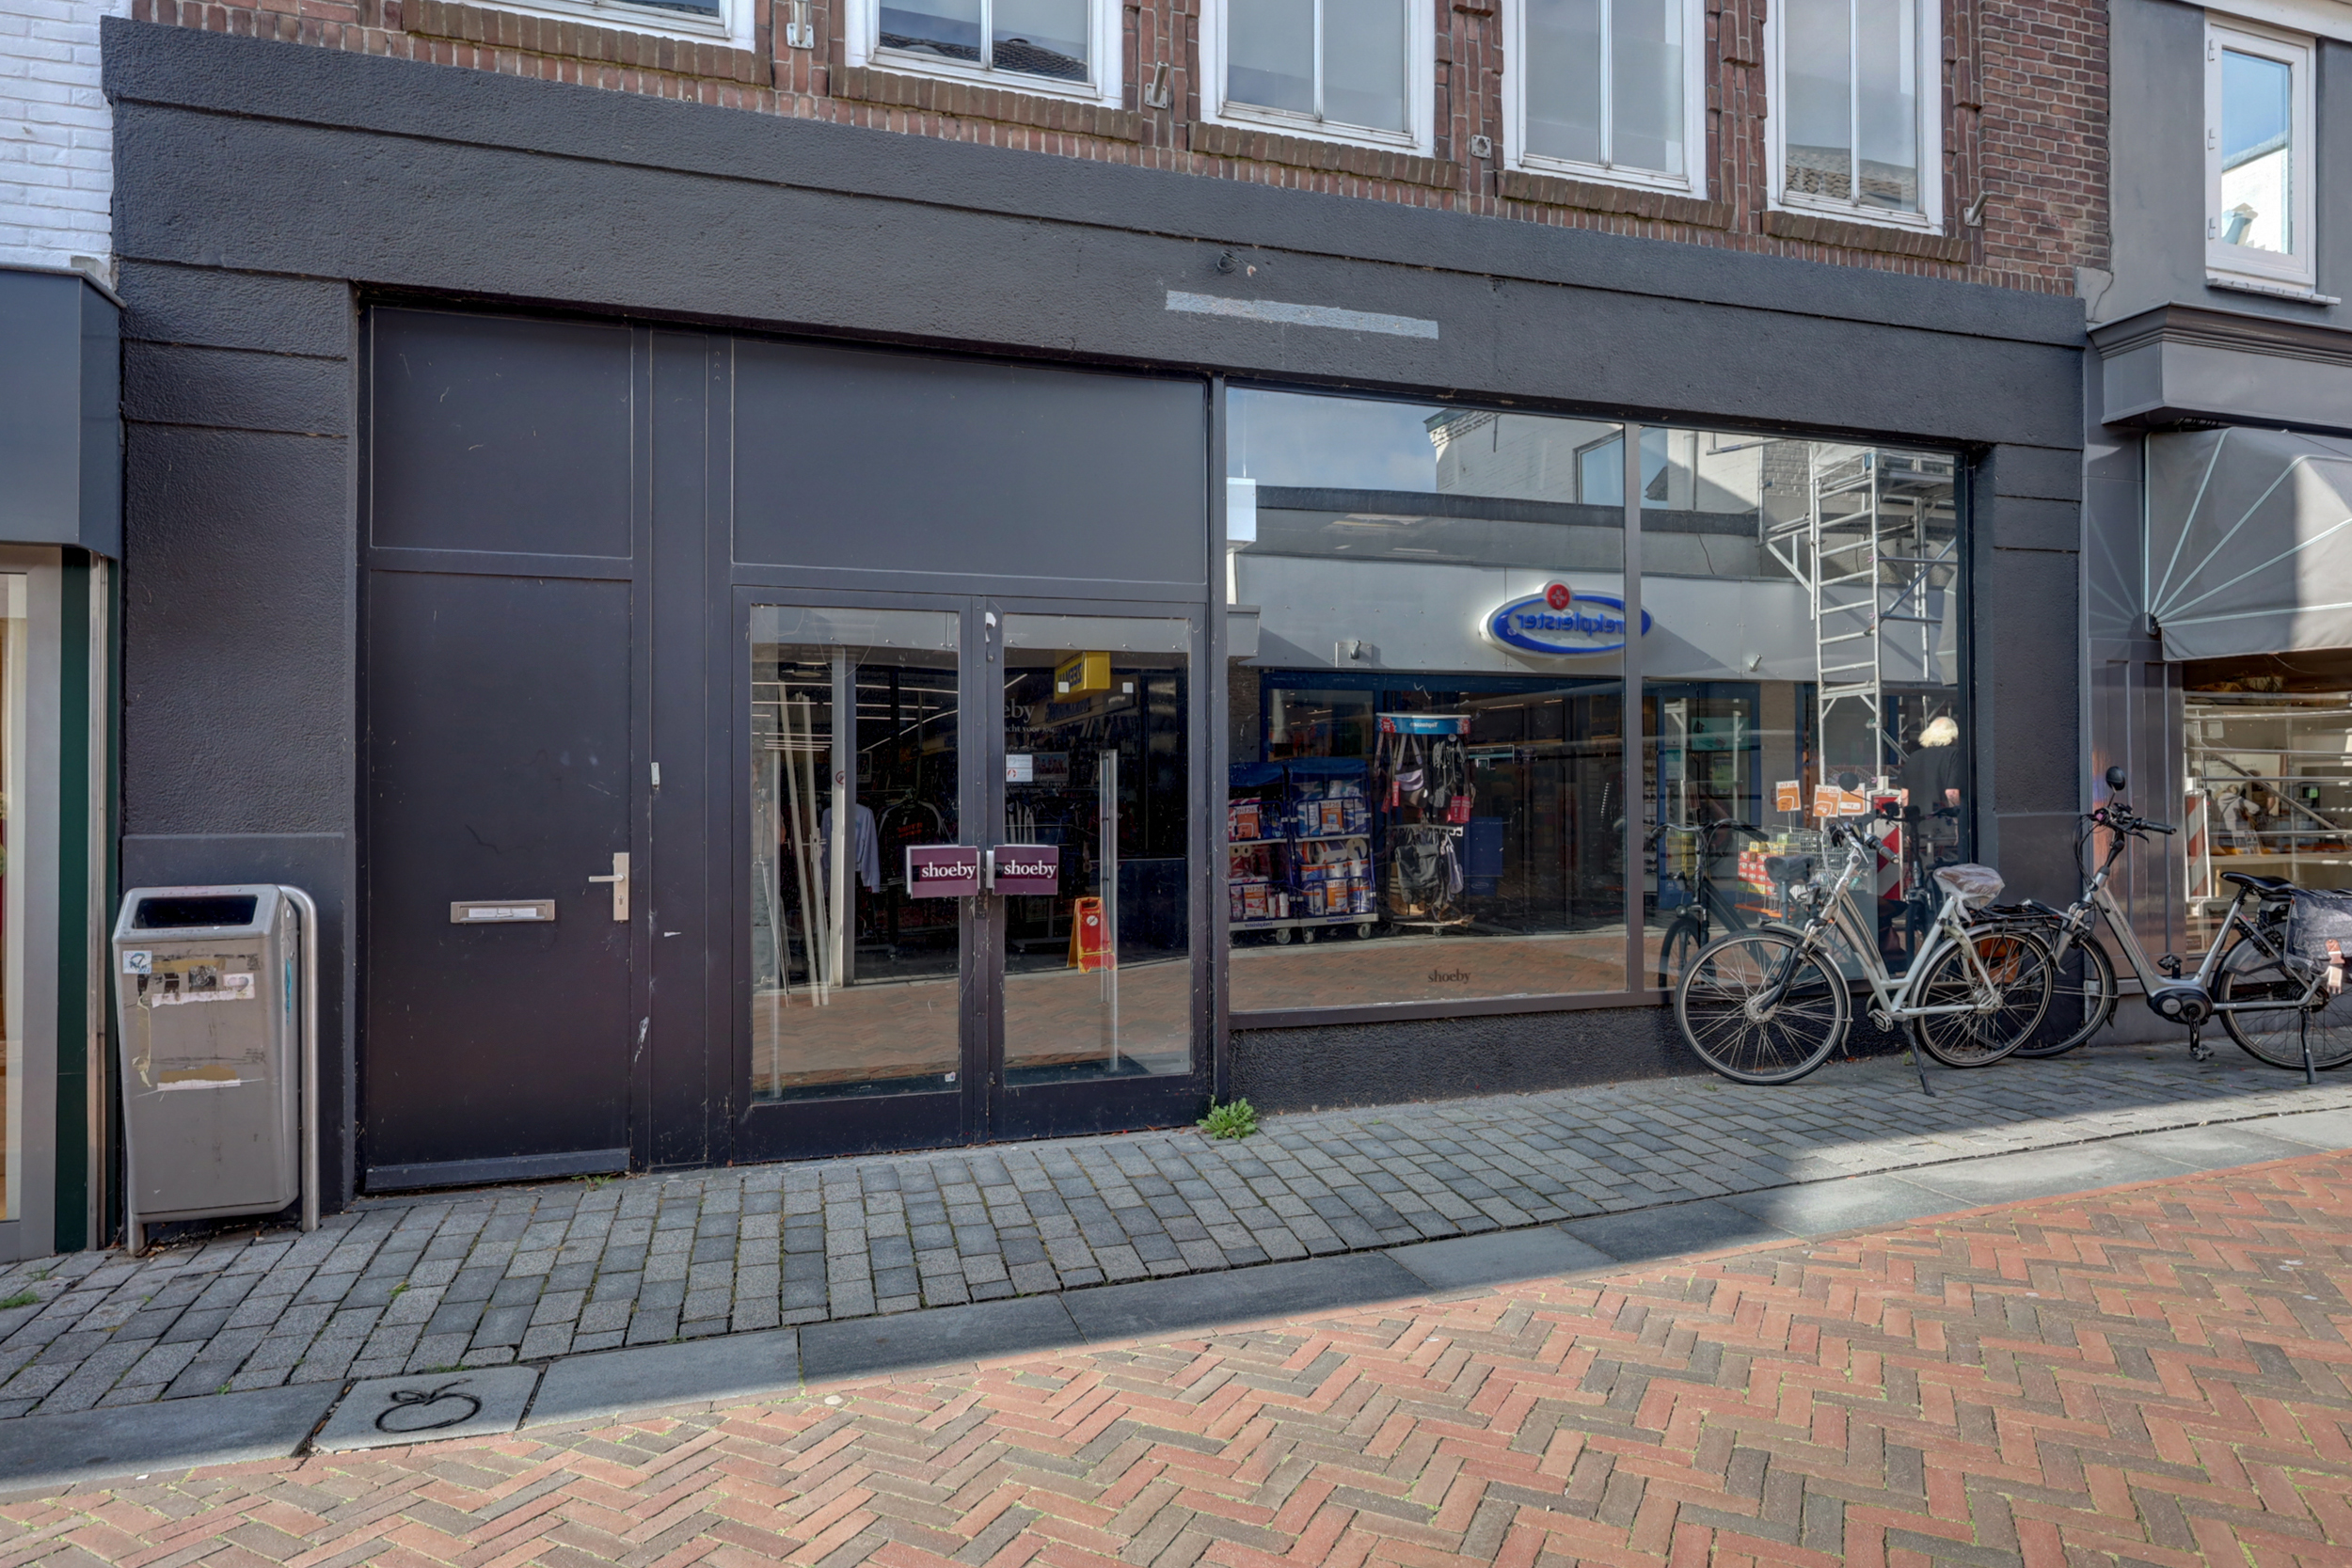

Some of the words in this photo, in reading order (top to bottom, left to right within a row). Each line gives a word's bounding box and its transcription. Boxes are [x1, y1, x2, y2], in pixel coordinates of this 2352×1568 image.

[921, 860, 977, 879] shoeby
[1003, 859, 1057, 879] shoeby
[1427, 969, 1471, 984] shoeby
